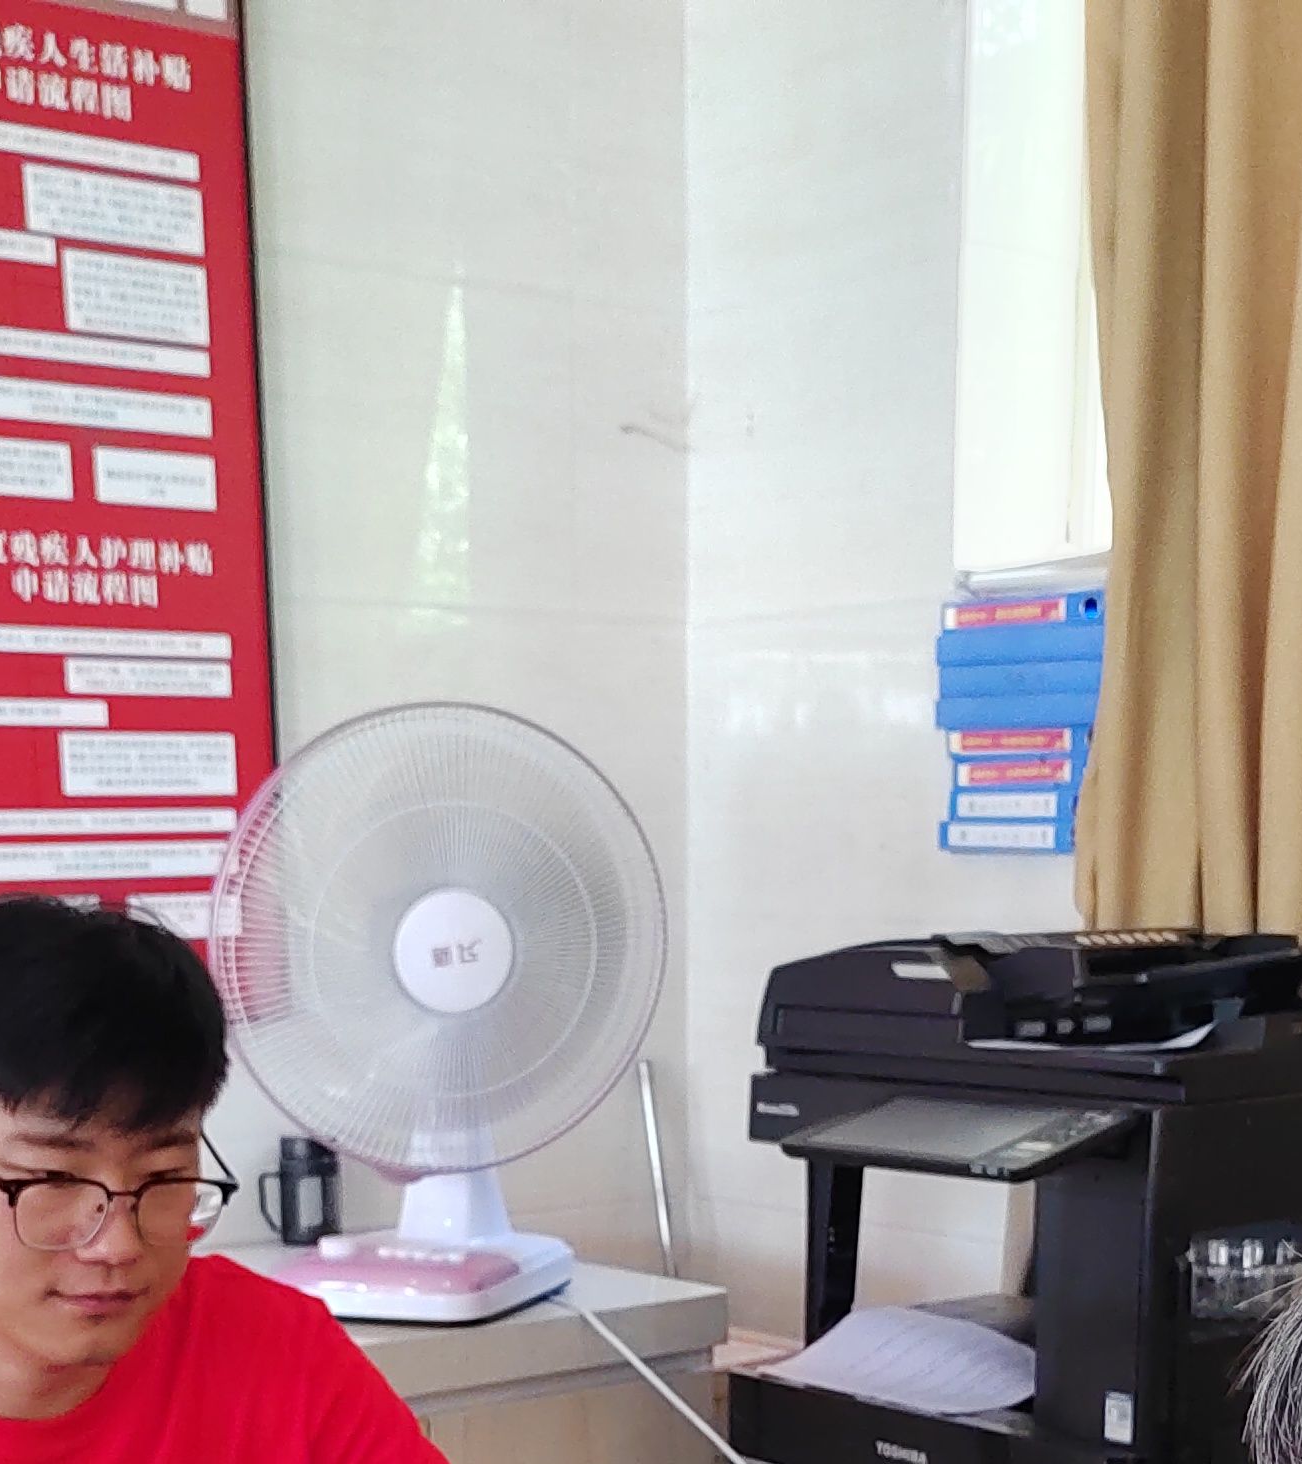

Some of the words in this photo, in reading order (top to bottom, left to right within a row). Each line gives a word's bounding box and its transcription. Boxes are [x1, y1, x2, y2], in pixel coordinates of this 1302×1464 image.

[12, 566, 159, 608] 申请流程图
